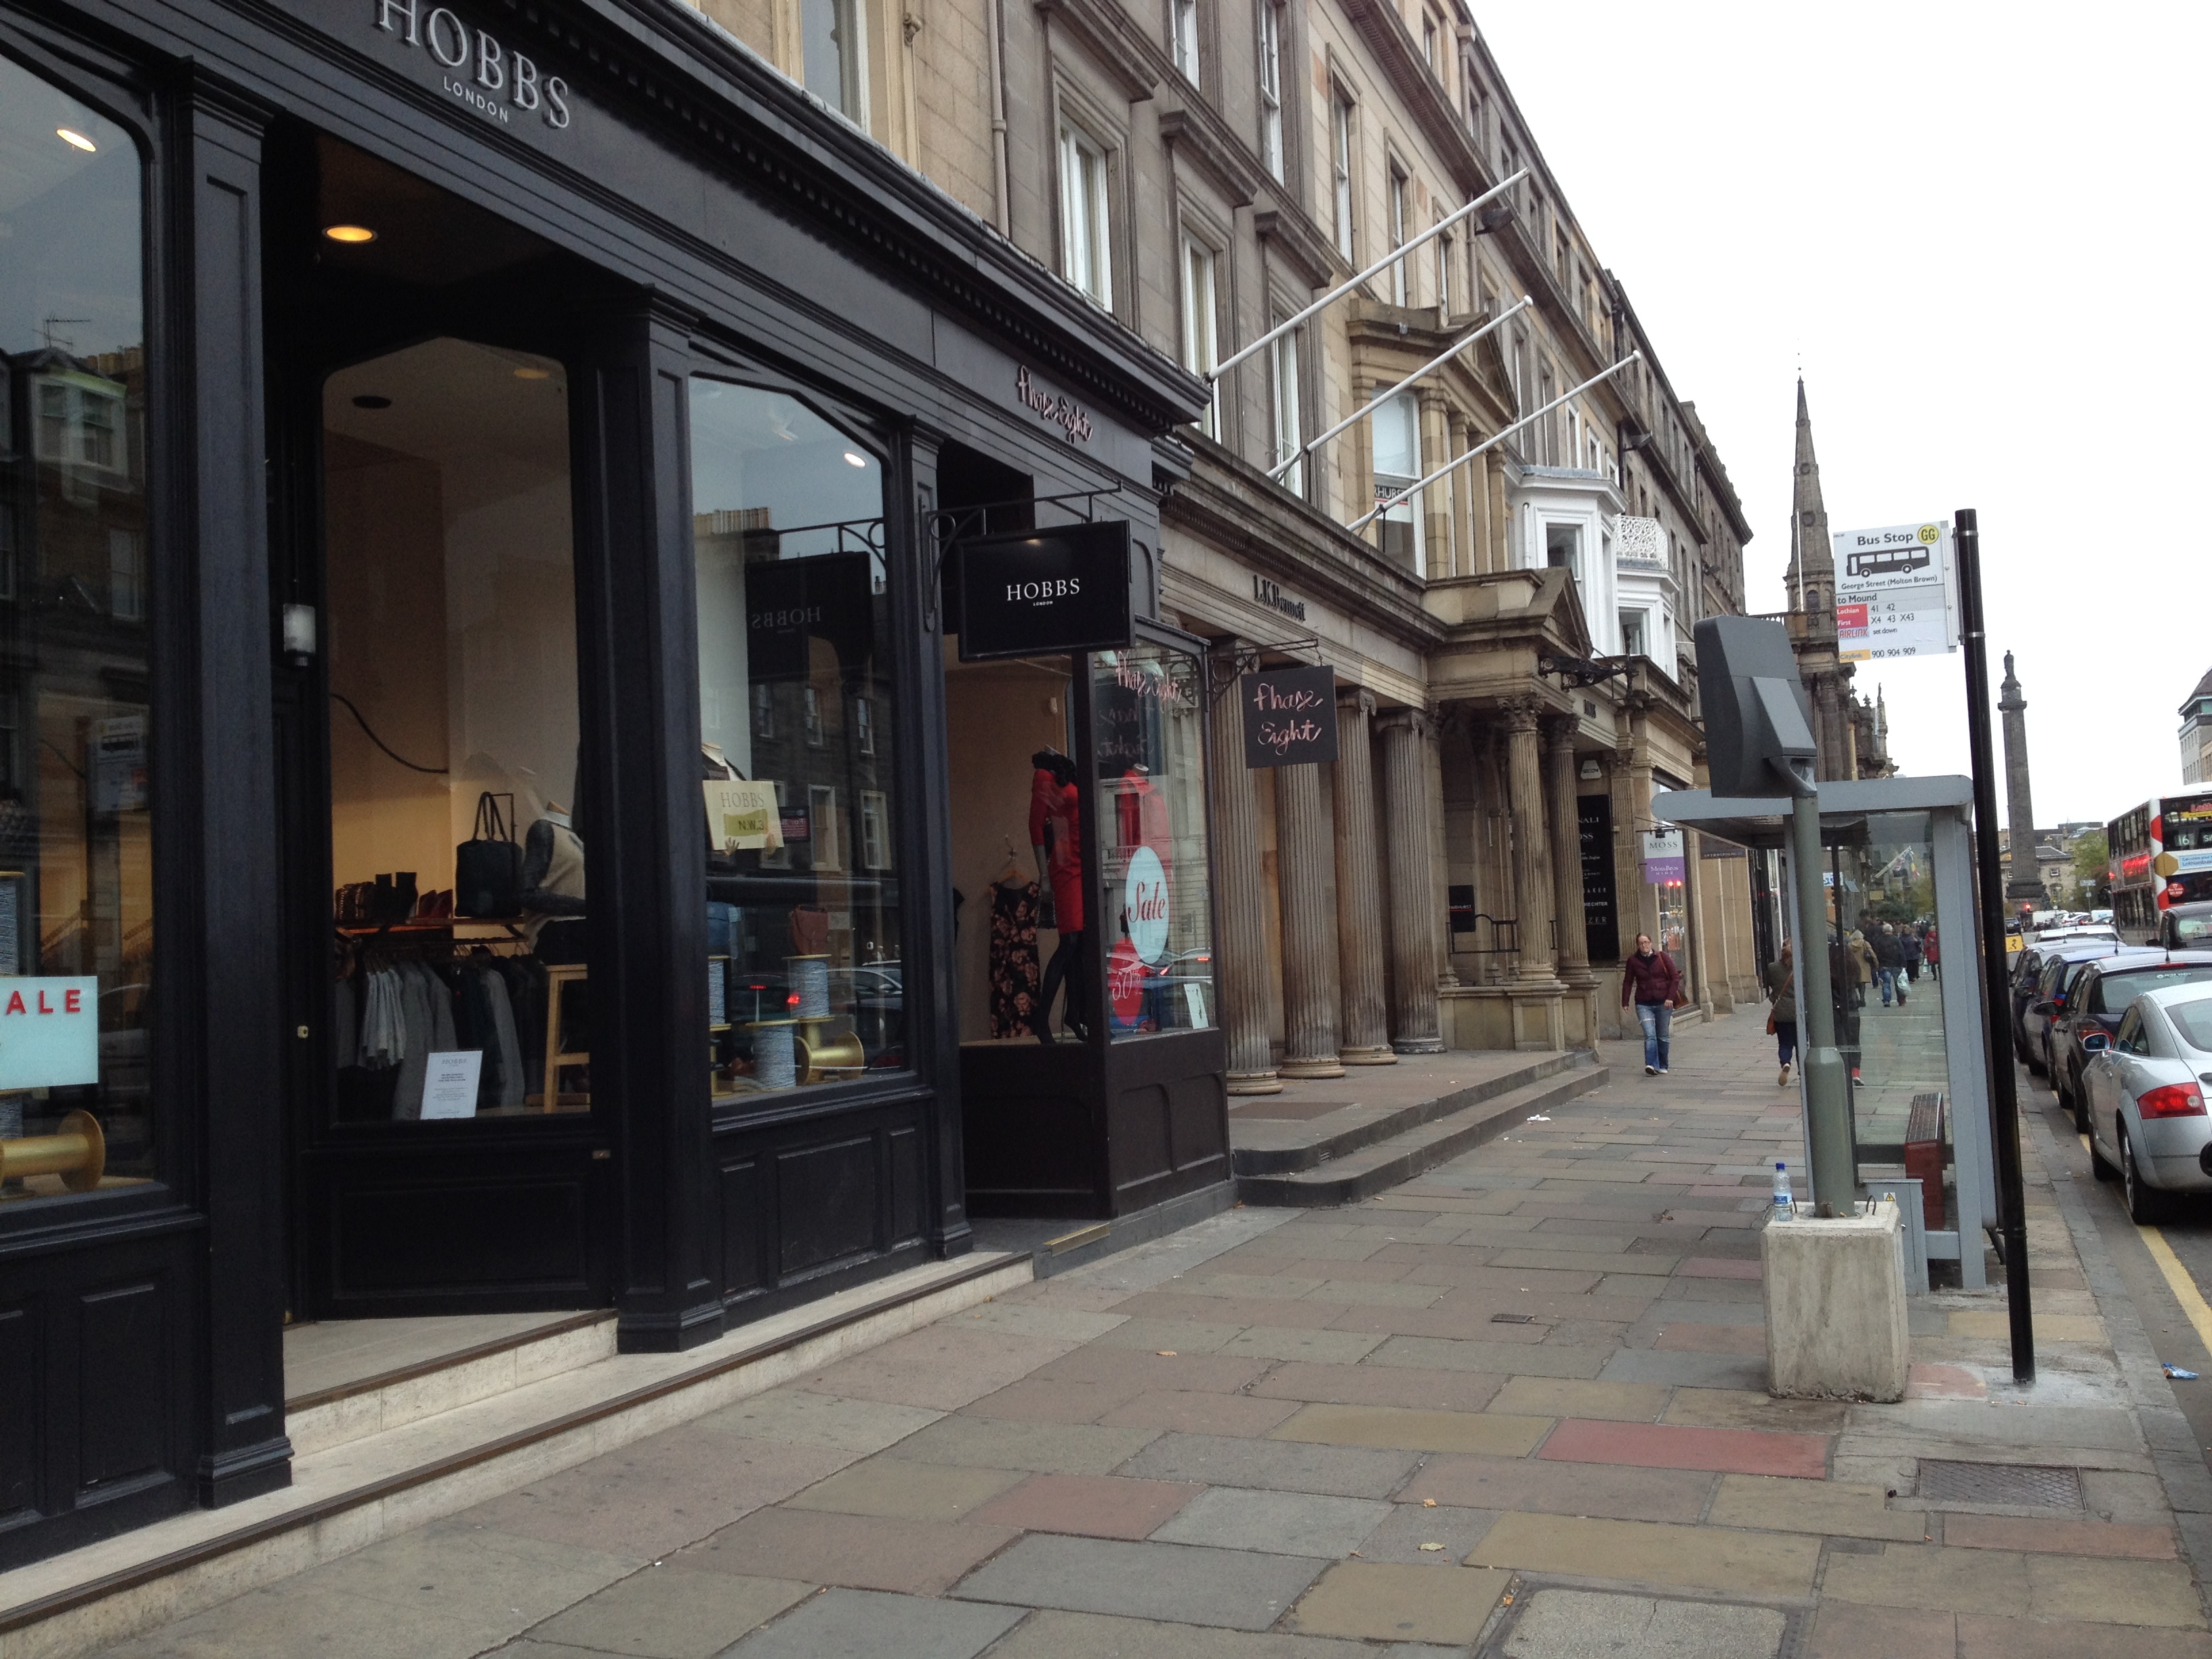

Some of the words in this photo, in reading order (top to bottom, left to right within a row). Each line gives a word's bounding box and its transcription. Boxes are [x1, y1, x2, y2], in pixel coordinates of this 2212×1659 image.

[379, 0, 570, 129] HOBBS
[443, 76, 510, 124] LONDON
[1857, 535, 1880, 546] Bus
[1884, 533, 1914, 543] Stop
[1921, 529, 1936, 541] GG
[1006, 578, 1080, 601] HOBBS
[1841, 582, 1864, 590] George
[1887, 578, 1912, 587] (Molton
[1914, 575, 1938, 583] Brown)
[1849, 593, 1877, 603] Mound
[1870, 605, 1879, 613] 41
[1887, 602, 1896, 611] 42
[1870, 616, 1881, 625] X4
[1887, 615, 1896, 623] 43
[1900, 613, 1914, 622] X43
[1872, 650, 1885, 658] 900
[1887, 649, 1900, 657] 904
[1903, 647, 1916, 655] 909
[1254, 682, 1324, 712] Phase
[1257, 719, 1322, 756] Eight
[720, 792, 765, 808] HOBBS
[737, 819, 764, 831] N.W.3
[1649, 841, 1678, 849] MOSS
[2178, 835, 2190, 846] 16
[1128, 881, 1166, 922] Sale
[6, 989, 81, 1015] ALE
